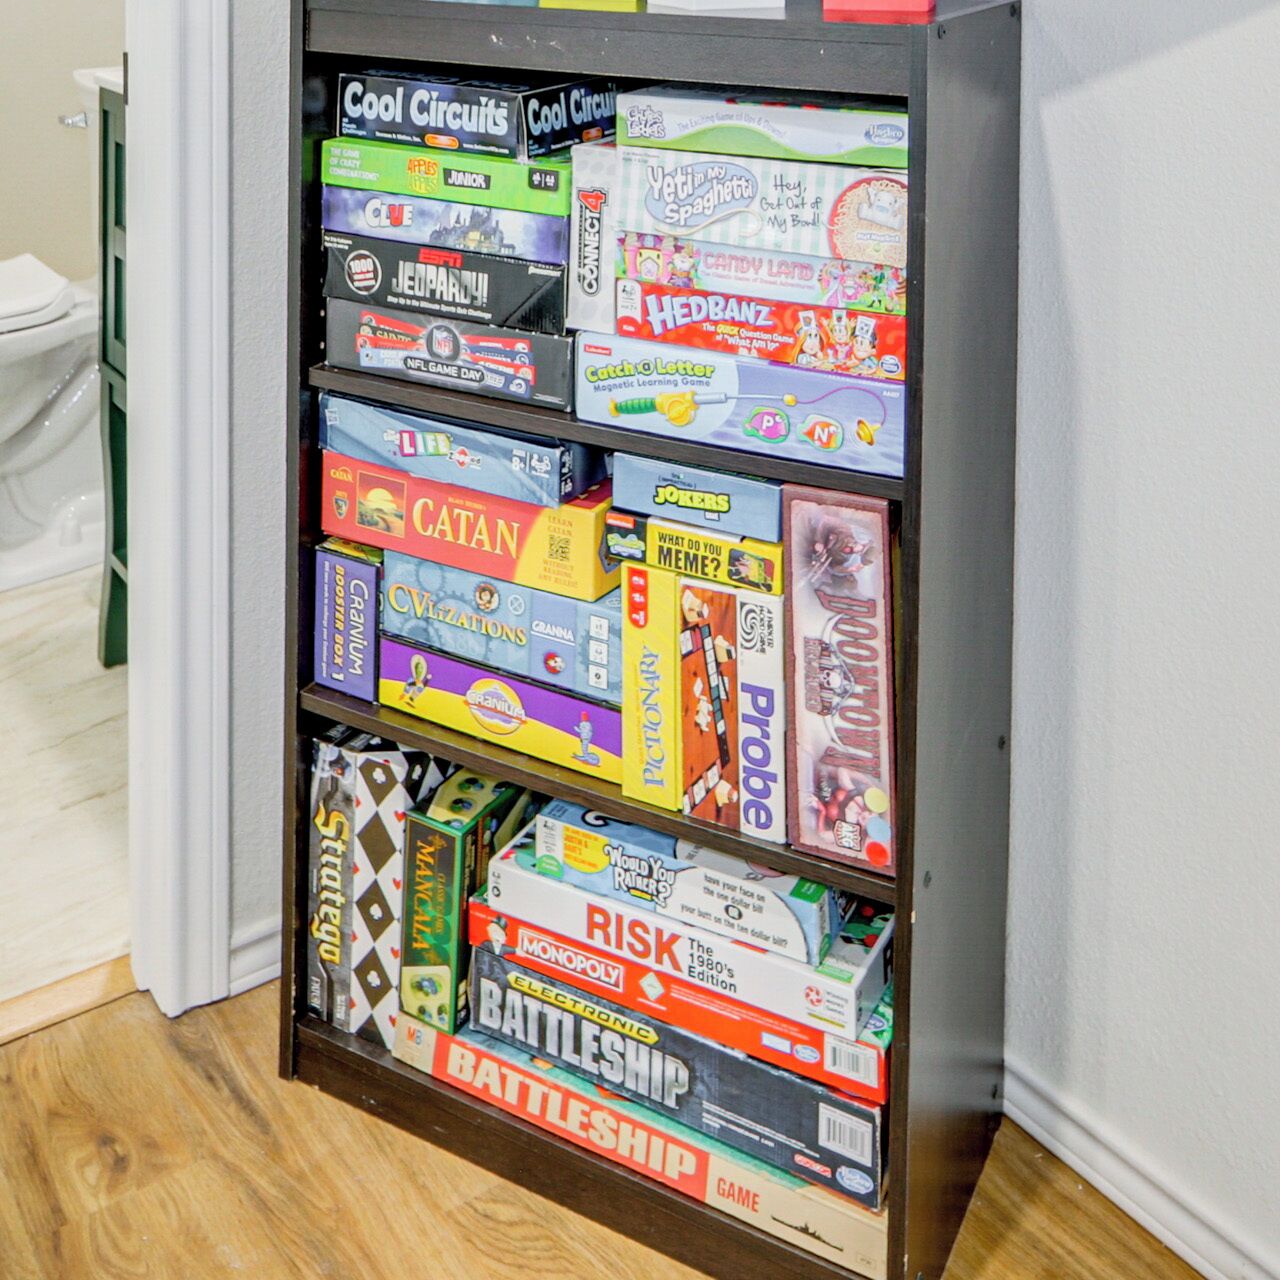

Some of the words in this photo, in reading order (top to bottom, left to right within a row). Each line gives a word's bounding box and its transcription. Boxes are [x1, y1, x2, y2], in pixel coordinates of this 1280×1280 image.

[344, 81, 404, 123] Cool
[409, 89, 510, 137] Circuits
[527, 91, 568, 137] Cool
[407, 157, 439, 176] APPLES
[448, 170, 486, 189] JUNIOR
[646, 165, 693, 202] Yeti
[693, 168, 706, 184] in
[707, 163, 728, 182] My
[773, 173, 808, 196] Hey,
[363, 198, 415, 228] CLUE
[578, 189, 607, 212] 4
[665, 179, 755, 227] Spaghetti
[760, 196, 783, 211] Get
[785, 196, 809, 212] Out
[809, 195, 823, 211] of
[767, 213, 788, 235] My
[790, 211, 821, 229] Bowl!
[349, 257, 373, 275] 1000
[417, 247, 464, 269] ESPN
[581, 210, 600, 295] CONNECT
[702, 251, 763, 275] CANDY
[767, 258, 815, 281] LAND
[391, 259, 489, 308] JEOPARDY!
[645, 293, 775, 337] HEDBANZ
[436, 340, 454, 354] NFL
[702, 322, 716, 333] The
[716, 323, 740, 335] QUICK
[740, 327, 773, 341] Question
[772, 332, 795, 345] Game
[751, 338, 766, 350] Am
[406, 359, 427, 373] NFL
[427, 362, 458, 377] GAME
[460, 367, 483, 382] DAY
[585, 359, 635, 383] Catch
[655, 357, 715, 379] Letter
[593, 379, 635, 393] Magnetic
[637, 377, 679, 389] Learning
[681, 377, 712, 387] Game
[401, 431, 451, 457] LIFE
[512, 456, 526, 471] 8+
[654, 486, 730, 512] JOKERS
[413, 497, 520, 560] CATAN
[547, 524, 573, 537] CATAN
[658, 531, 686, 550] WHAT
[687, 537, 701, 553] DO
[702, 540, 723, 557] YOU
[657, 545, 722, 579] MEME?
[335, 564, 345, 632] BOOSTER
[348, 578, 370, 676] CRANIUM
[532, 620, 575, 641] GRANNA
[334, 633, 345, 668] BOX
[331, 671, 345, 682] 1
[814, 589, 881, 780] DOOMTOWN
[465, 690, 527, 721] CRANIUM
[642, 645, 666, 788] PICTIONARY
[740, 682, 778, 831] Probe
[603, 844, 650, 870] WOULD
[650, 861, 676, 885] YOU
[310, 800, 351, 966] Stratego
[411, 840, 437, 951] MANCALA
[614, 868, 673, 908] RATHER?
[704, 872, 720, 886] have
[722, 880, 738, 893] your
[739, 884, 755, 899] face
[703, 885, 715, 897] the
[716, 891, 730, 902] one
[730, 895, 751, 910] dollar
[752, 901, 765, 915] bill
[586, 903, 685, 973] RISK
[680, 902, 697, 916] your
[723, 917, 736, 930] the
[736, 922, 750, 934] ten
[750, 927, 772, 942] dollar
[772, 934, 789, 949] bill?
[520, 934, 622, 986] MONOPOLY
[689, 936, 714, 958] The
[688, 965, 738, 995] Edition
[689, 951, 735, 980] 1980's
[514, 975, 650, 1041] ELECTRONIC
[478, 977, 690, 1110] BATTLESHIP
[446, 1043, 698, 1181] BATTLESHIP
[716, 1176, 760, 1214] GAME
